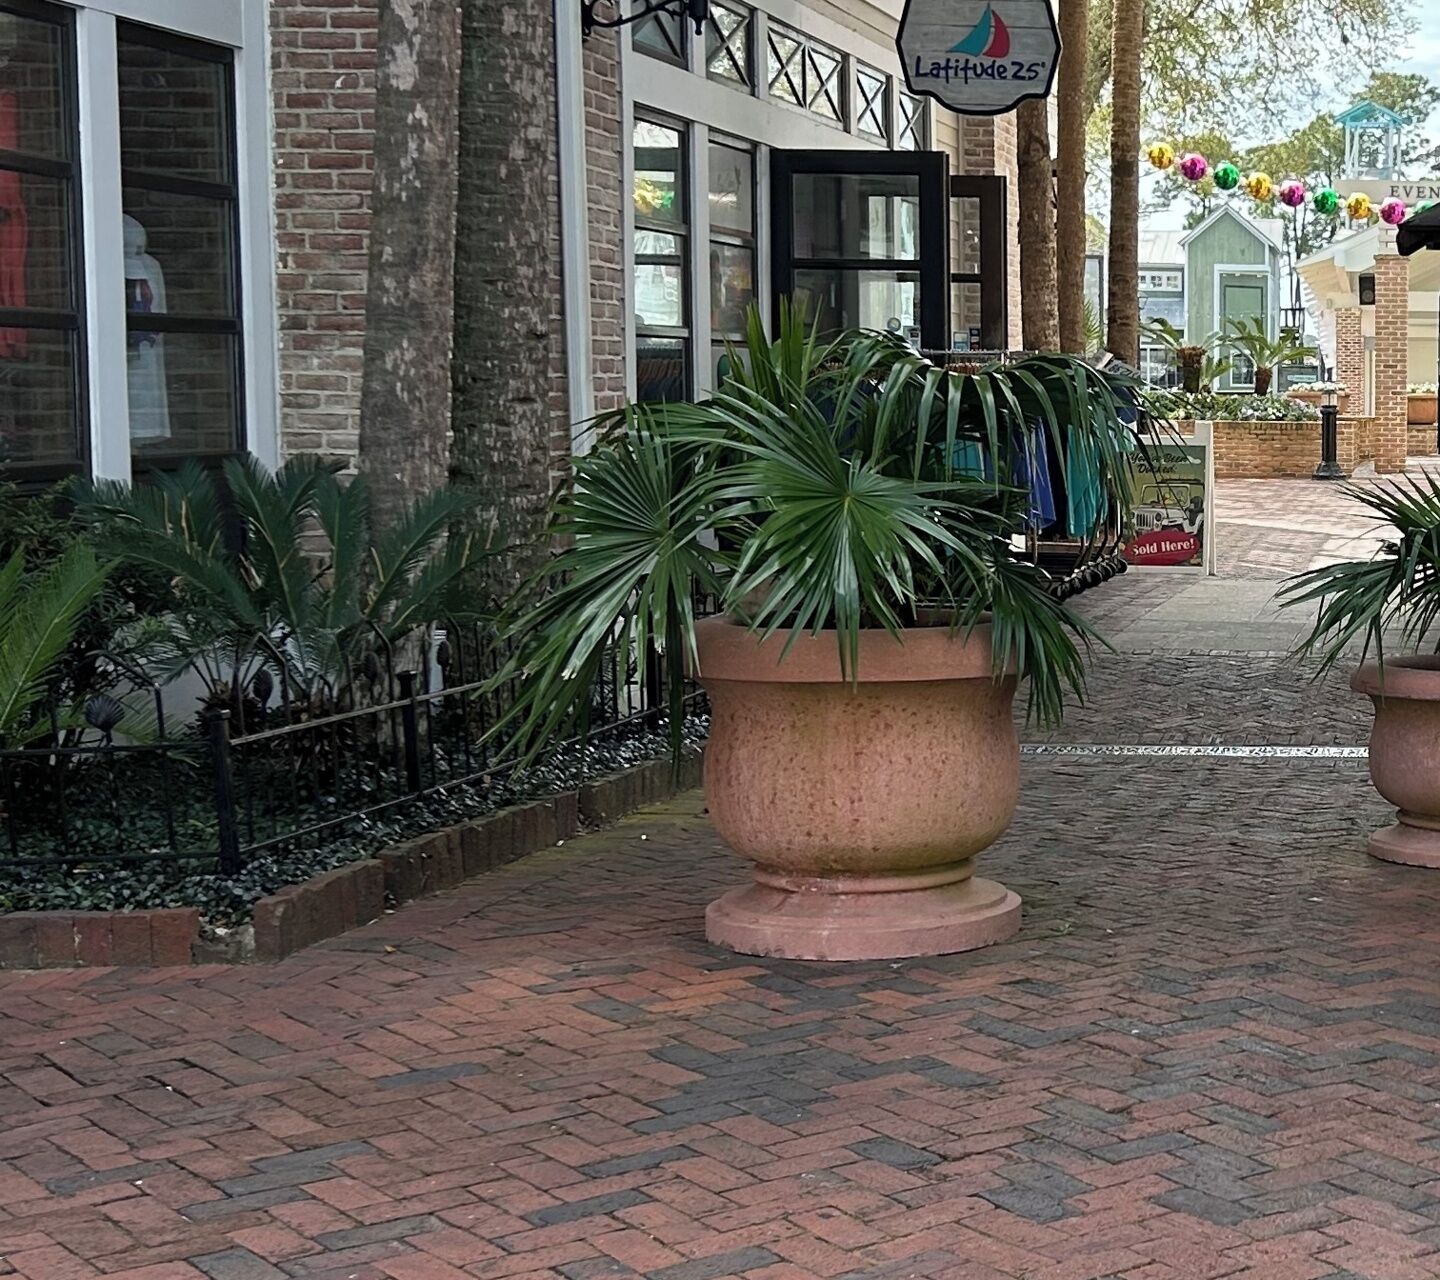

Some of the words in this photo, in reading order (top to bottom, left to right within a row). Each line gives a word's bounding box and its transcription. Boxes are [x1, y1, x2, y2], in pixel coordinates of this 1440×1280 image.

[914, 55, 1007, 84] Latitude
[1132, 543, 1158, 556] Sold
[1161, 538, 1195, 553] Here!
